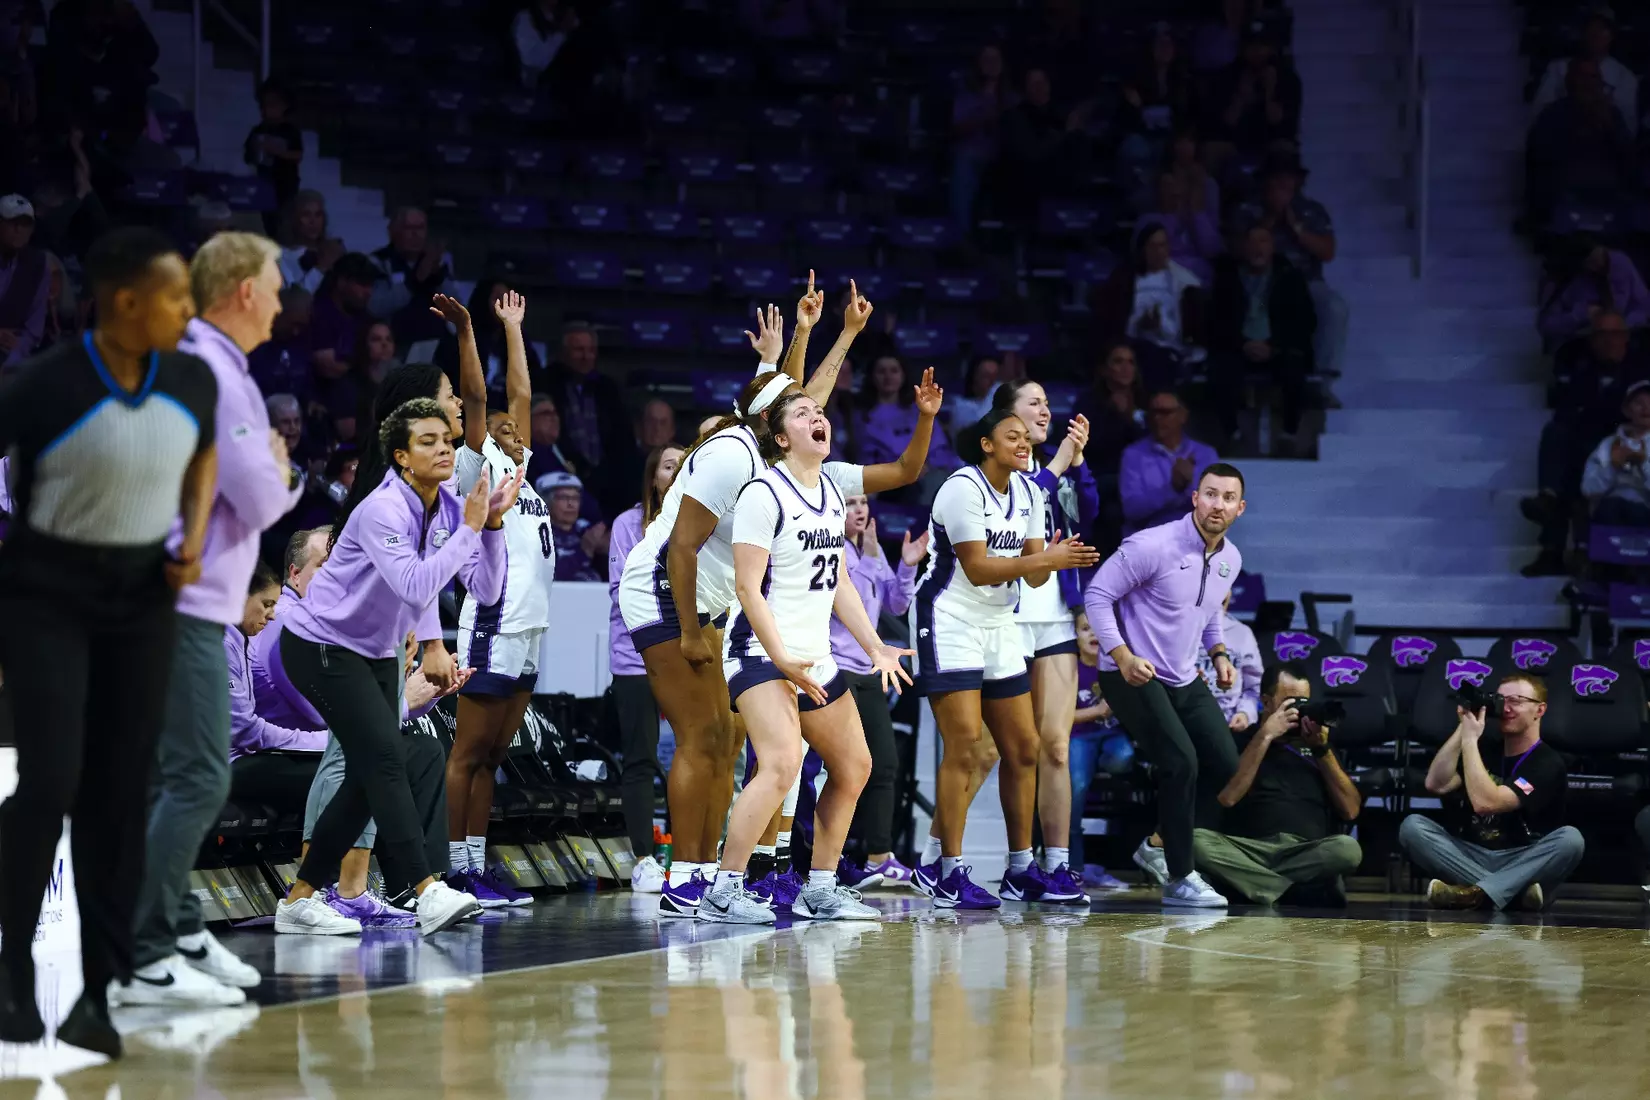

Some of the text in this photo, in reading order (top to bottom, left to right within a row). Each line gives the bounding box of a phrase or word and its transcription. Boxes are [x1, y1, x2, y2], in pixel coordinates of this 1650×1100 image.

[537, 522, 552, 560] 0
[796, 527, 845, 552] Wildca
[985, 528, 1026, 551] Wildc
[808, 553, 839, 592] 23
